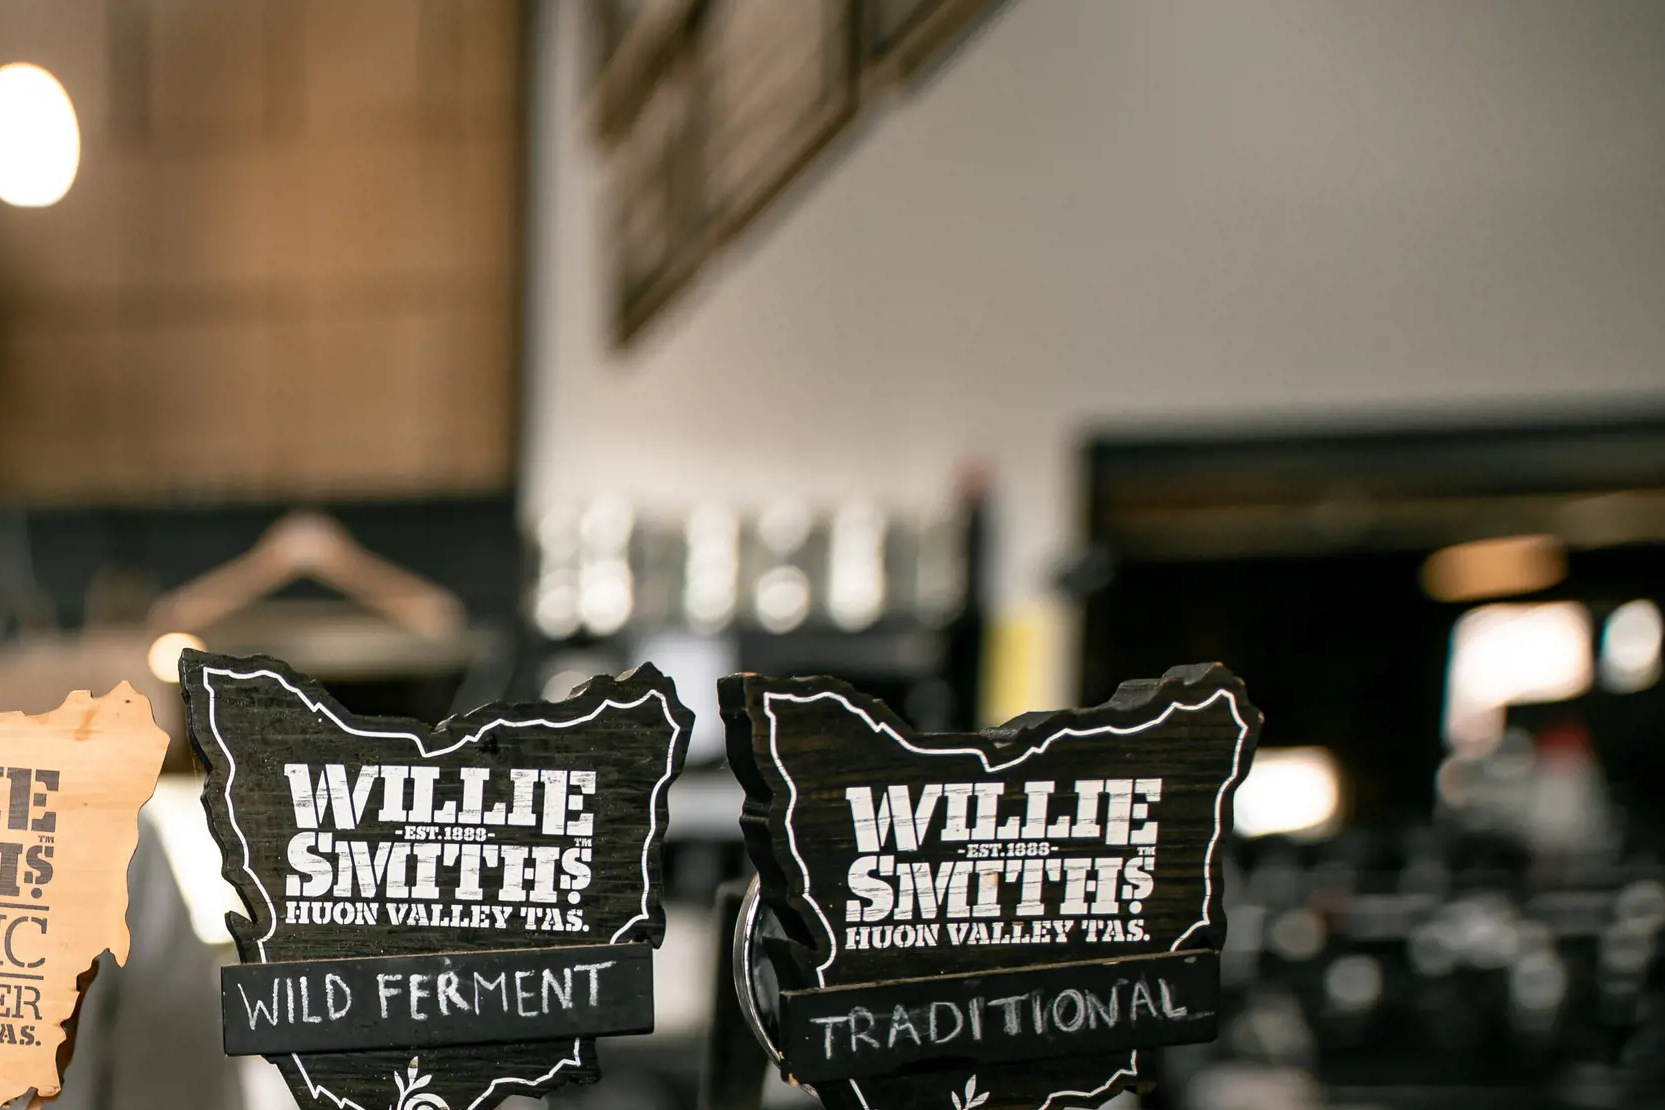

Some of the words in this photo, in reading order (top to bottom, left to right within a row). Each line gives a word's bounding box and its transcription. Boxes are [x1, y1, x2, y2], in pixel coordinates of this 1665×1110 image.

[284, 763, 597, 836] WILLIE
[845, 778, 1162, 853] WILLIE
[285, 901, 379, 925] HUON
[386, 903, 513, 928] VALLEY
[520, 906, 590, 932] TAS.
[845, 923, 940, 949] HUON
[946, 920, 1074, 946] VALLEY
[1081, 919, 1151, 943] TAS.
[237, 973, 352, 1030] WILD
[376, 961, 616, 1020] FERMENT
[808, 977, 1192, 1060] TRADITIONAL
